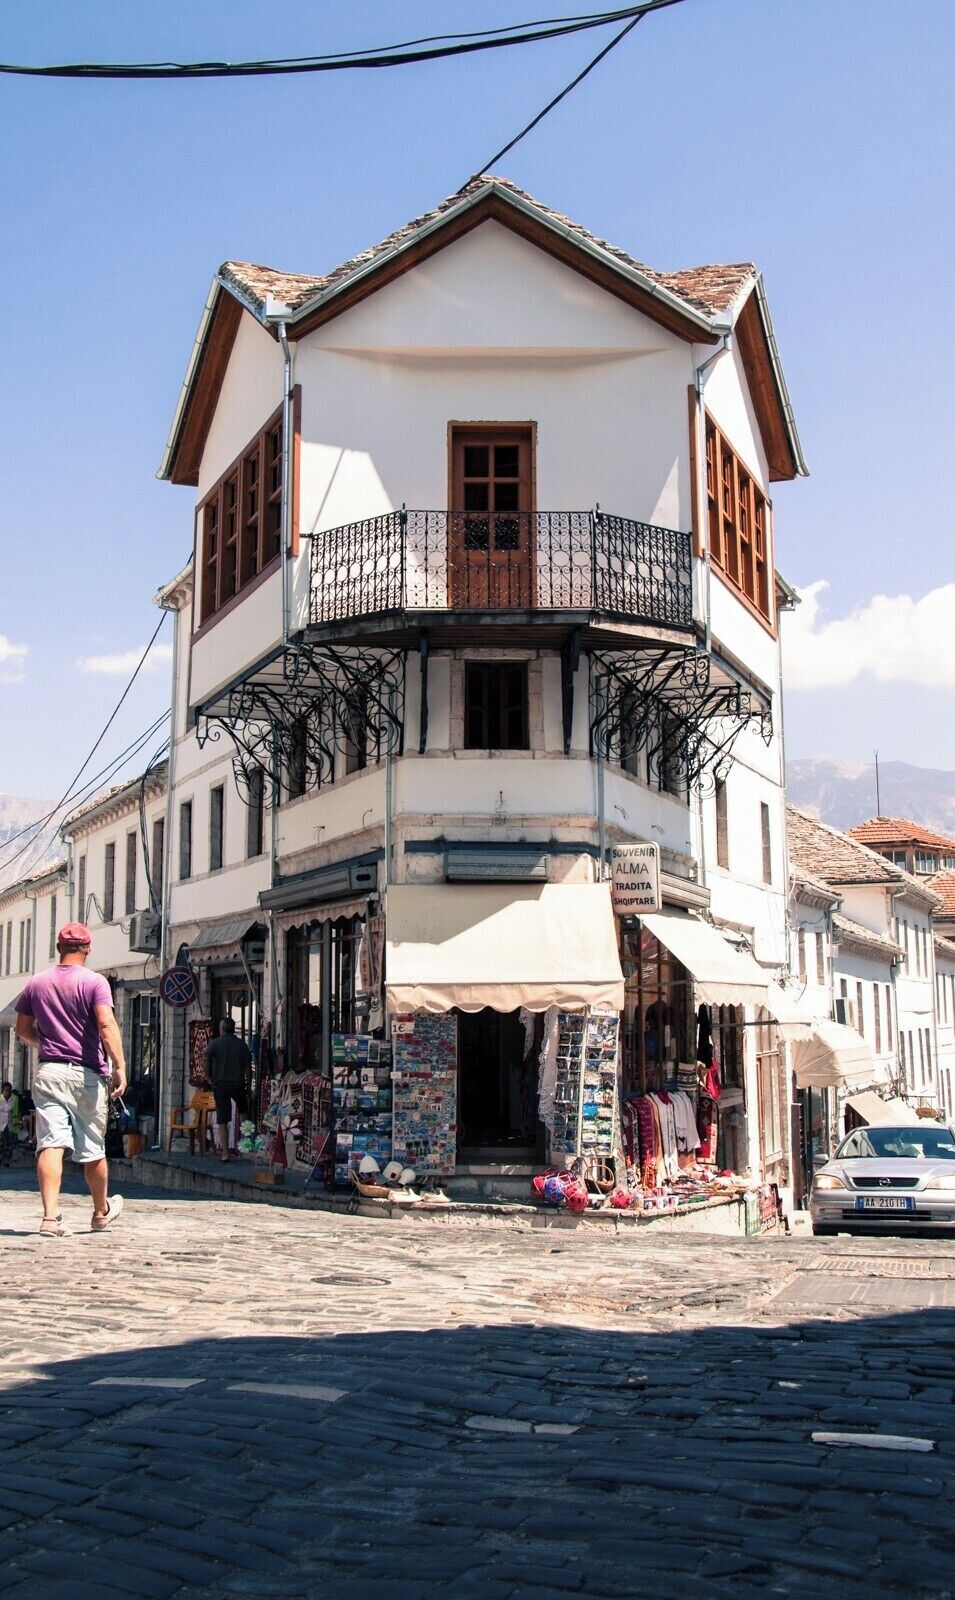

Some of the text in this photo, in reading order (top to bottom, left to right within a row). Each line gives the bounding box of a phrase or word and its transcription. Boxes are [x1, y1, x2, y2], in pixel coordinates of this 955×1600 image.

[612, 847, 655, 858] SOUVENIR
[616, 863, 649, 874] ALMA
[615, 881, 652, 891] TRADITA
[614, 896, 655, 906] SHQIPTARE
[865, 1198, 875, 1207] AA
